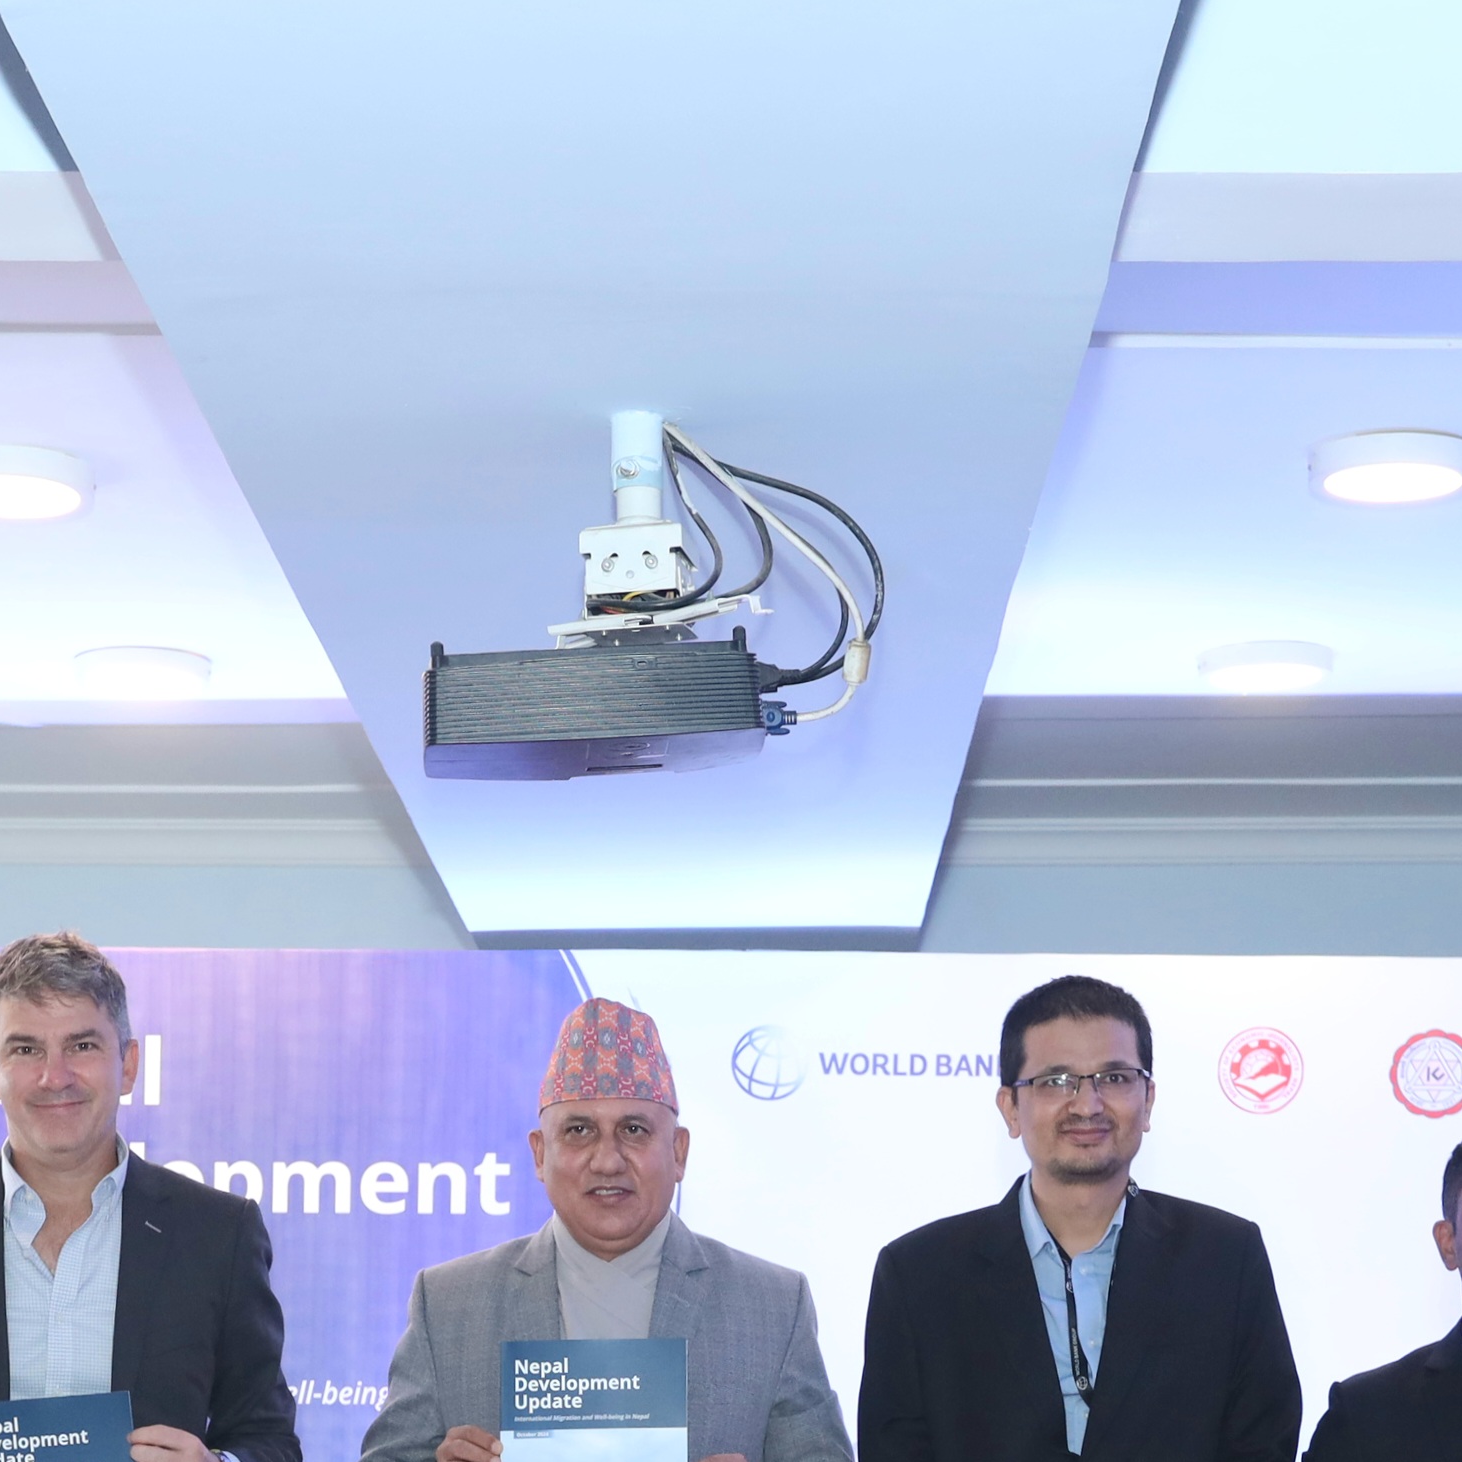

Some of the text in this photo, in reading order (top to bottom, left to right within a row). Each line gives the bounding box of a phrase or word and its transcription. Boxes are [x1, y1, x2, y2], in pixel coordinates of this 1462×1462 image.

[819, 1052, 1001, 1077] WORLD BAN
[514, 1357, 569, 1378] Nepal
[514, 1375, 640, 1395] Development
[288, 1380, 388, 1412] ll-being
[514, 1393, 583, 1413] Update
